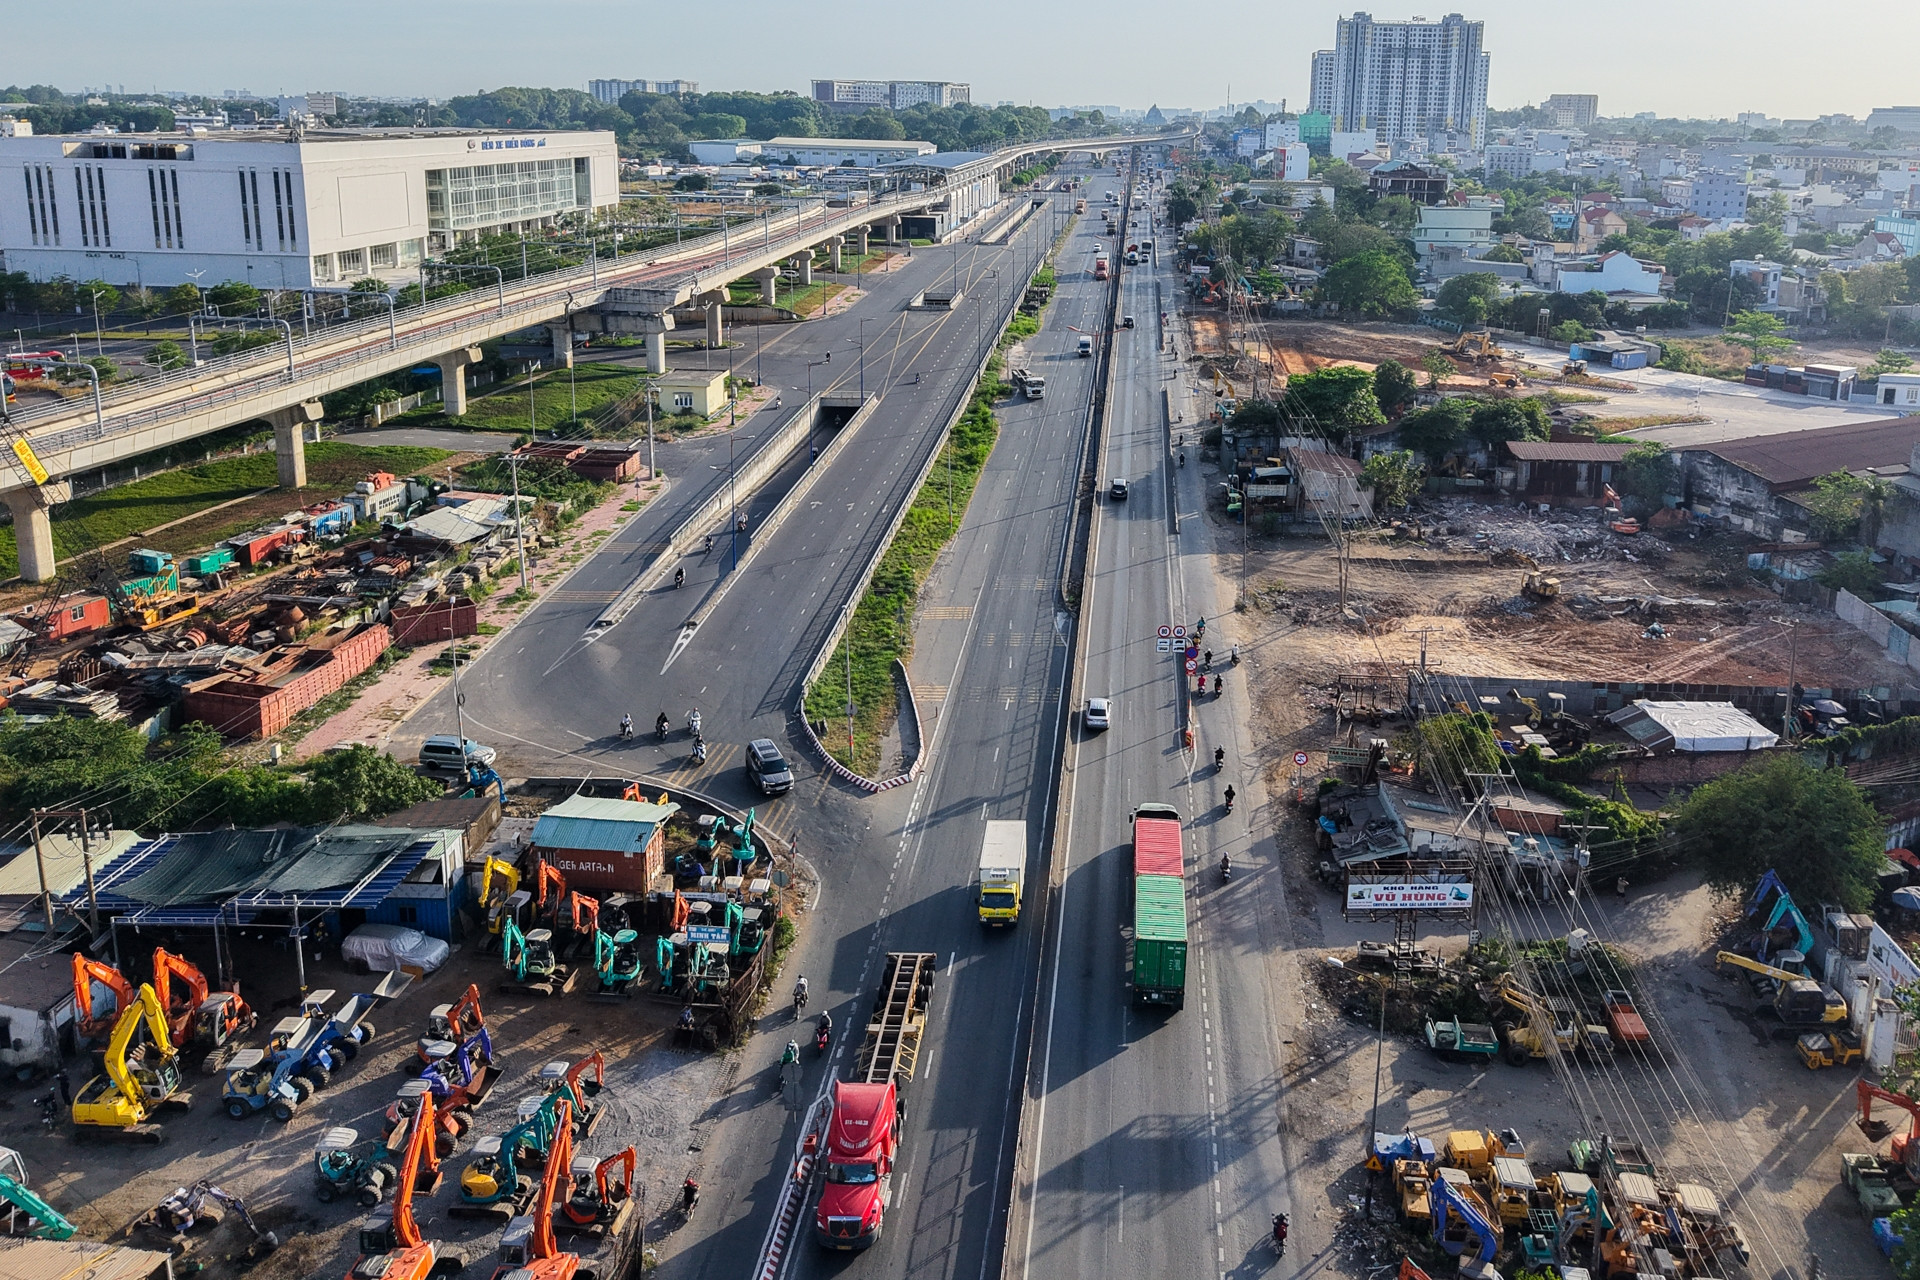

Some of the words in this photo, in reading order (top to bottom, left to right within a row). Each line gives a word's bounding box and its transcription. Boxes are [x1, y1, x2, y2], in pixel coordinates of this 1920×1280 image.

[495, 140, 504, 149] XE
[1374, 891, 1397, 902] VŨ
[1401, 891, 1447, 901] HÙNG
[710, 932, 727, 940] TÂM
